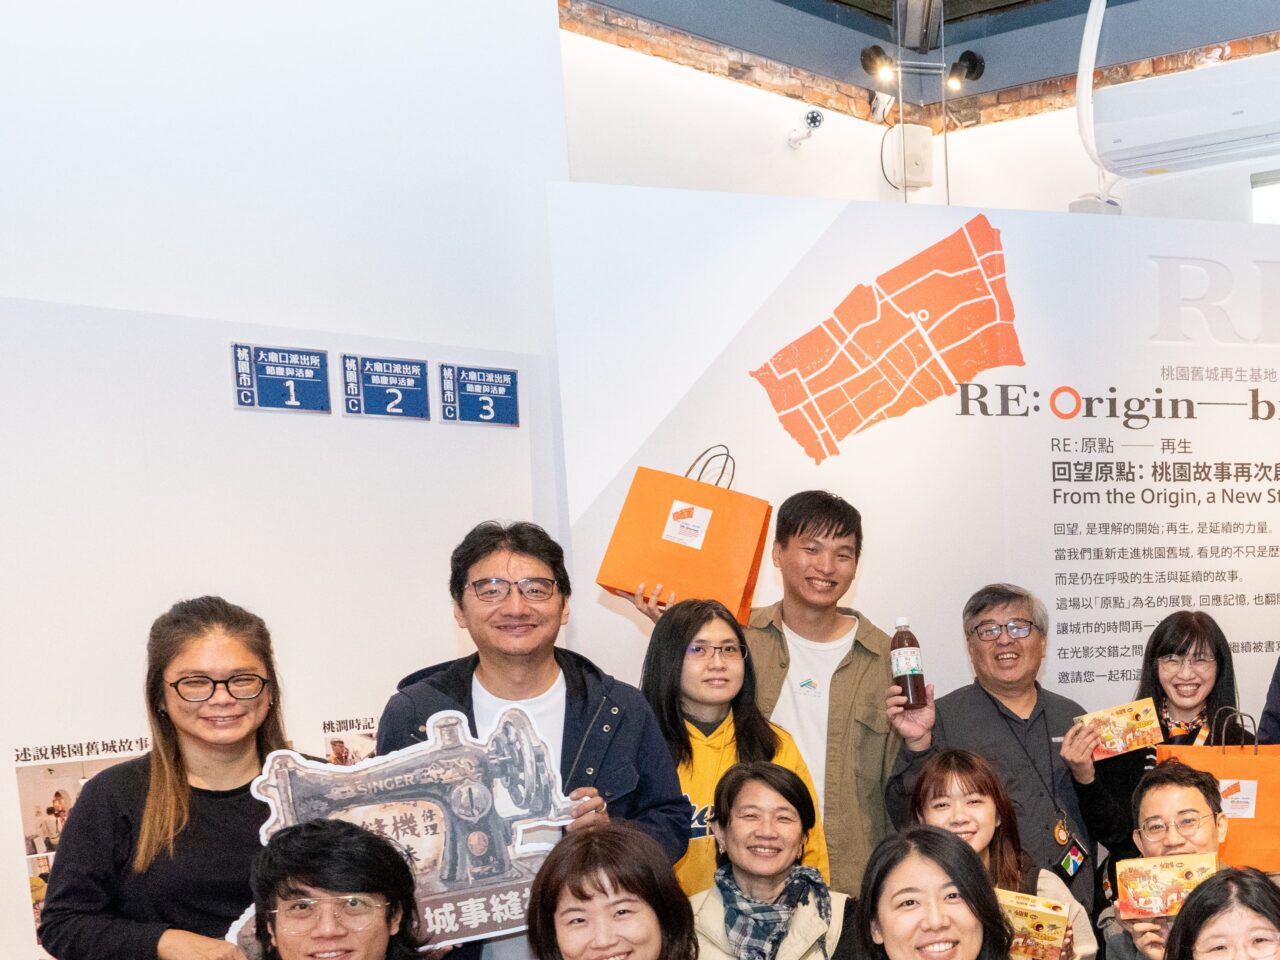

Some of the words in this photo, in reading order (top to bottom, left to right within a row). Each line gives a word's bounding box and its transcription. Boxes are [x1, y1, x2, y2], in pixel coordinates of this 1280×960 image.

[237, 347, 251, 387] 桃園市
[345, 358, 358, 395] 桃園市
[1160, 365, 1277, 384] 桃園舊城再生基地
[282, 379, 301, 406] 1
[442, 367, 455, 403] 桃園市
[240, 390, 252, 404] C
[348, 399, 359, 411] C
[385, 388, 403, 414] 2
[478, 396, 495, 420] 3
[445, 406, 455, 418] C
[1160, 437, 1193, 455] 再生
[1053, 489, 1100, 505] From
[1106, 488, 1136, 505] the
[1140, 487, 1201, 509] Origin,
[1206, 493, 1216, 505] a
[1221, 488, 1262, 504] New
[1056, 619, 1161, 636] 讓城市的時間再一
[14, 736, 150, 763] 述說桃園舊城故事
[356, 775, 415, 796] SINGER
